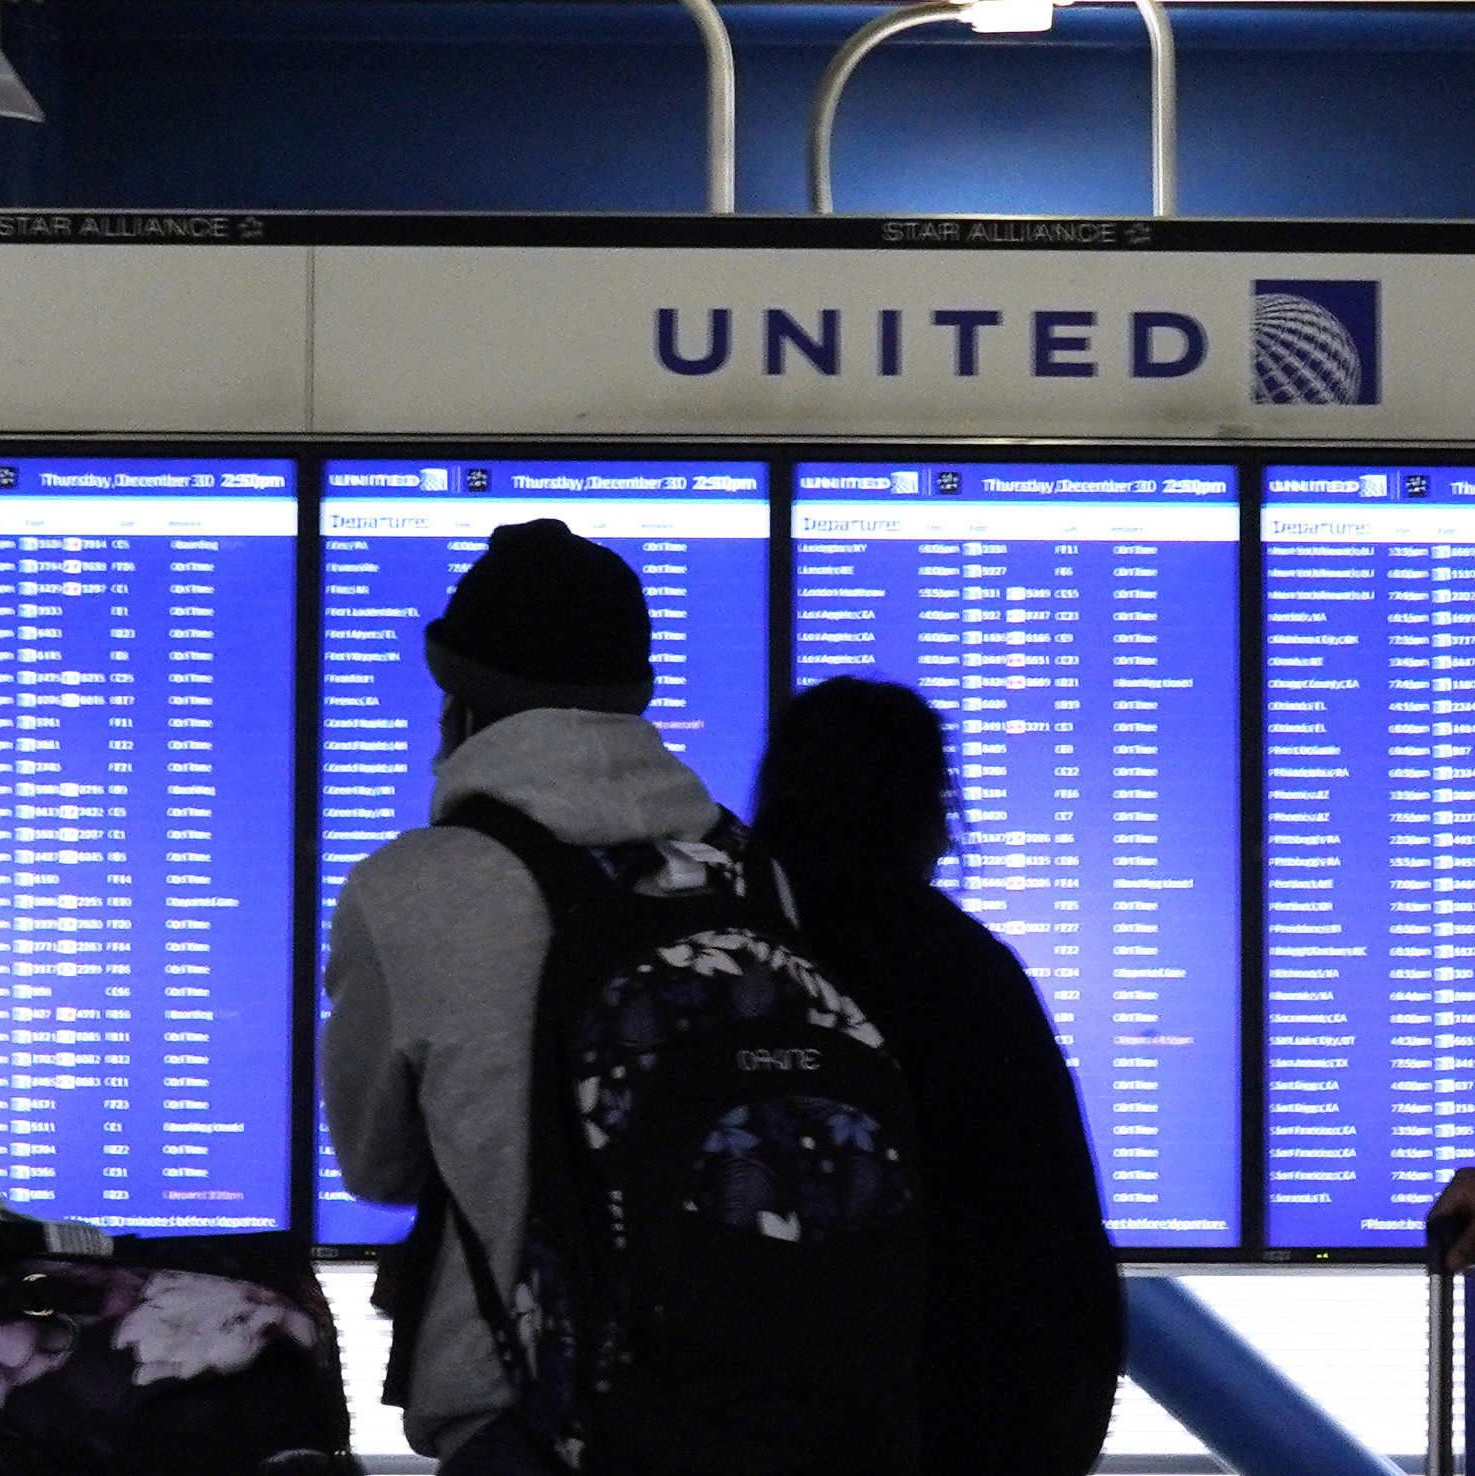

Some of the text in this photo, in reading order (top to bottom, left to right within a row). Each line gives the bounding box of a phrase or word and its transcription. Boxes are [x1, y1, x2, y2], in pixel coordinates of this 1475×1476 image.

[79, 216, 228, 238] ALLIANCE
[883, 222, 1116, 243] STAR ALLIANCE
[656, 306, 1210, 379] UNITED
[115, 474, 190, 487] December
[585, 476, 660, 489] December
[1055, 479, 1132, 493] December
[330, 514, 432, 530] Departures
[801, 517, 904, 533] Departures
[1272, 521, 1371, 535] Departures
